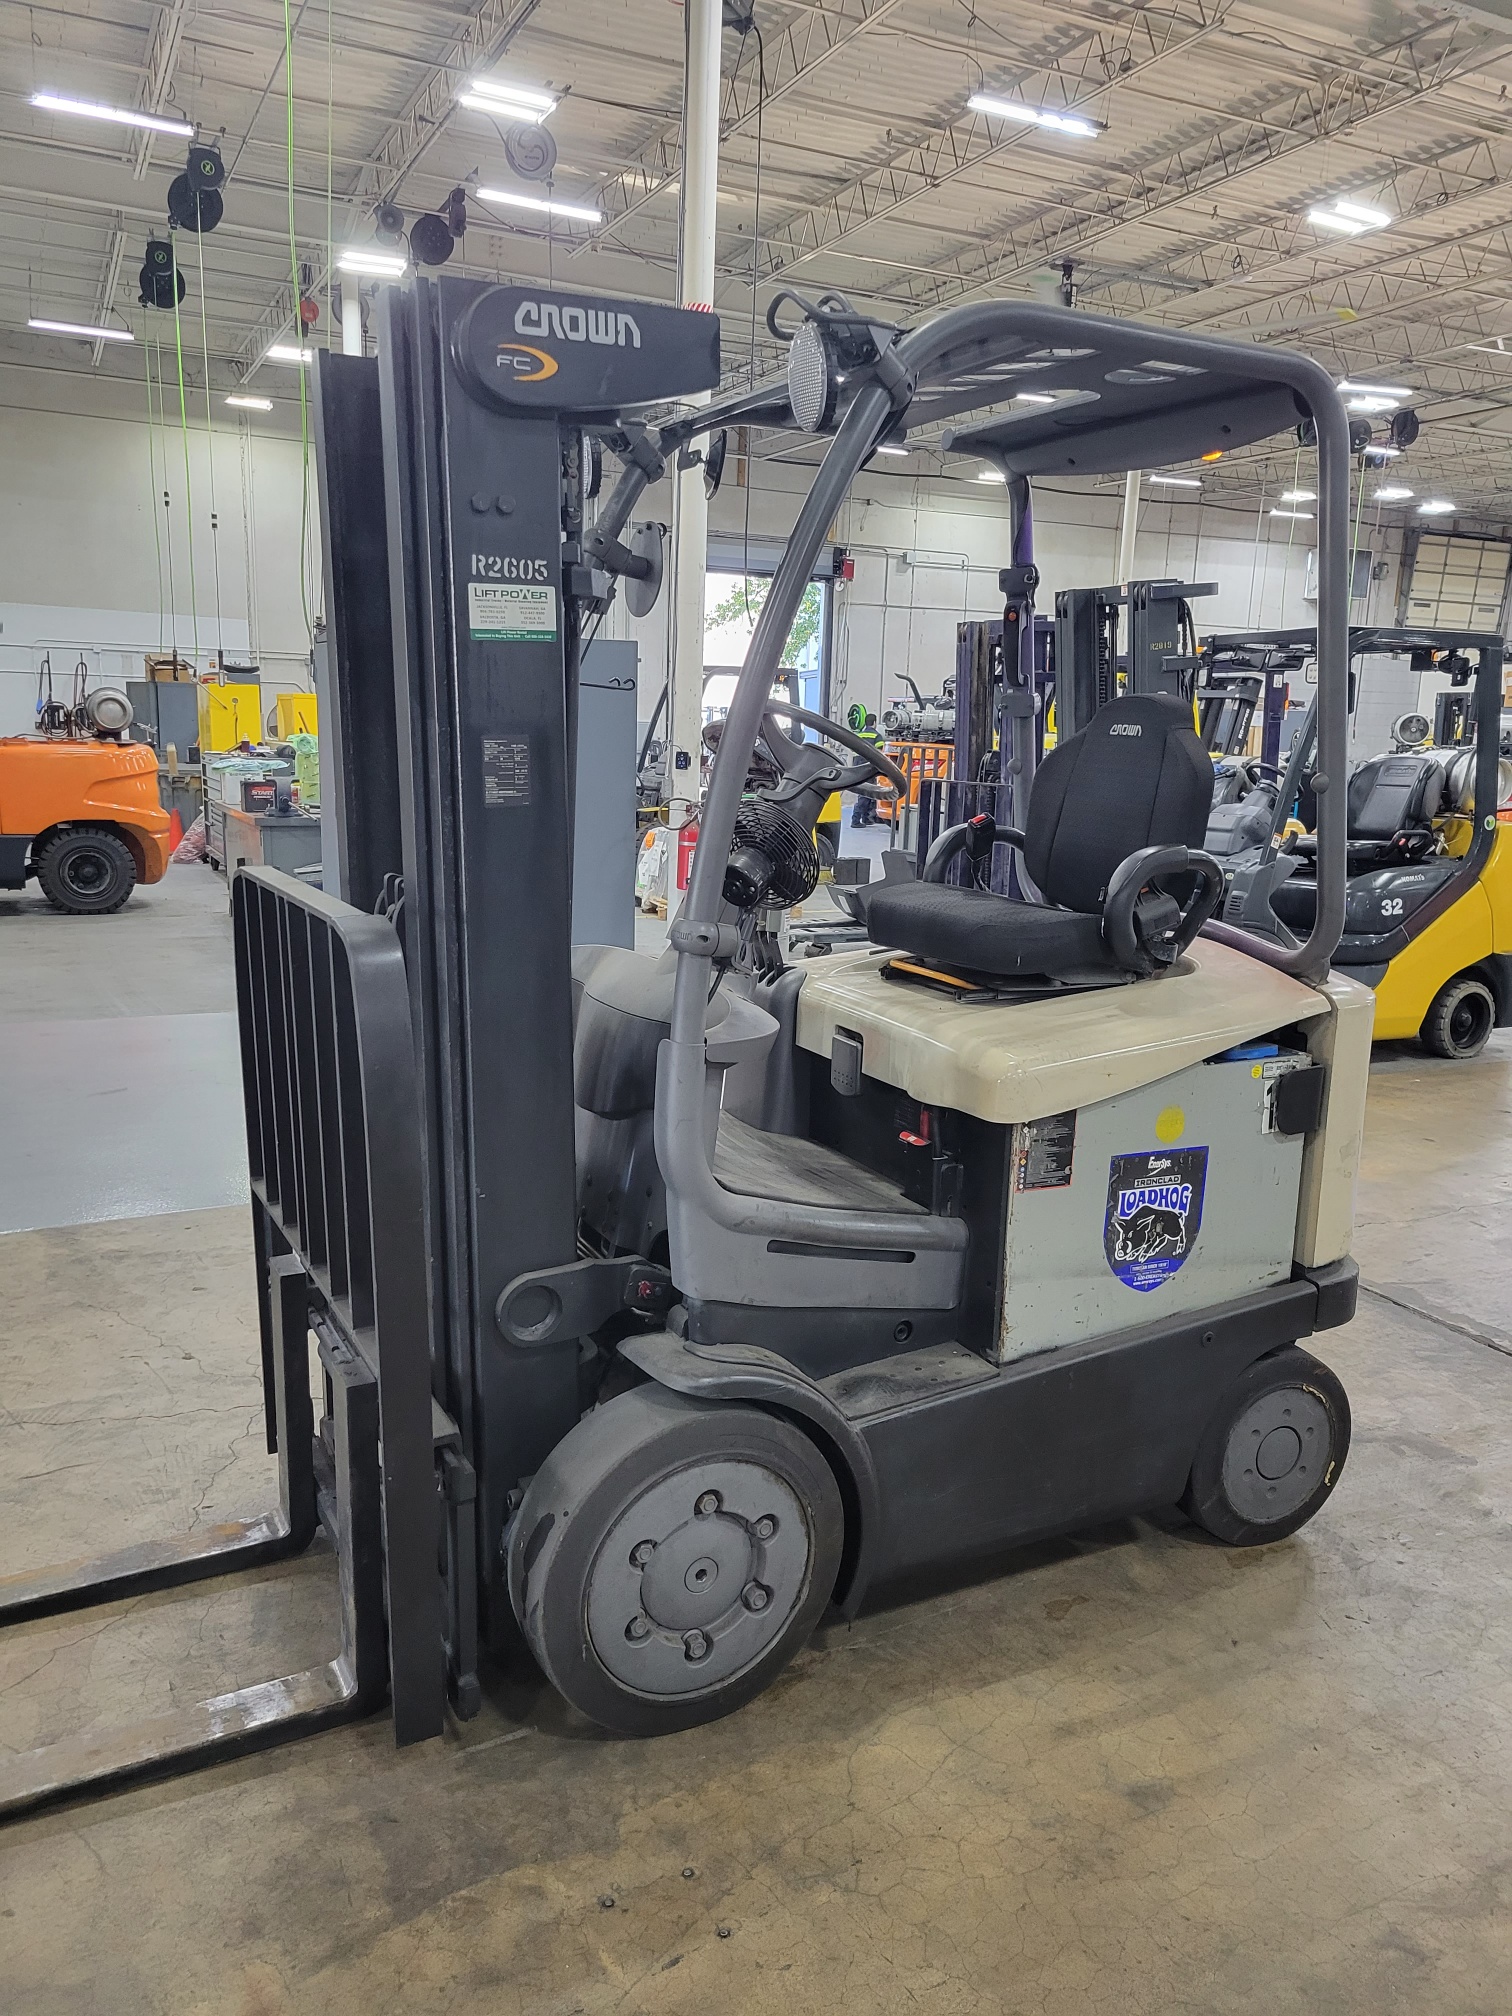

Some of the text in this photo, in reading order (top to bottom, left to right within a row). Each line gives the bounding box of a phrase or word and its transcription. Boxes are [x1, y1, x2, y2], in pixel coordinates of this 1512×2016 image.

[514, 301, 640, 349] CROWN
[496, 355, 531, 370] FC
[472, 554, 548, 581] R2605
[1109, 724, 1142, 737] CROWN
[1381, 898, 1403, 916] 32
[1136, 1176, 1180, 1188] IRONCLAD
[1118, 1183, 1193, 1220] LOADHOG
